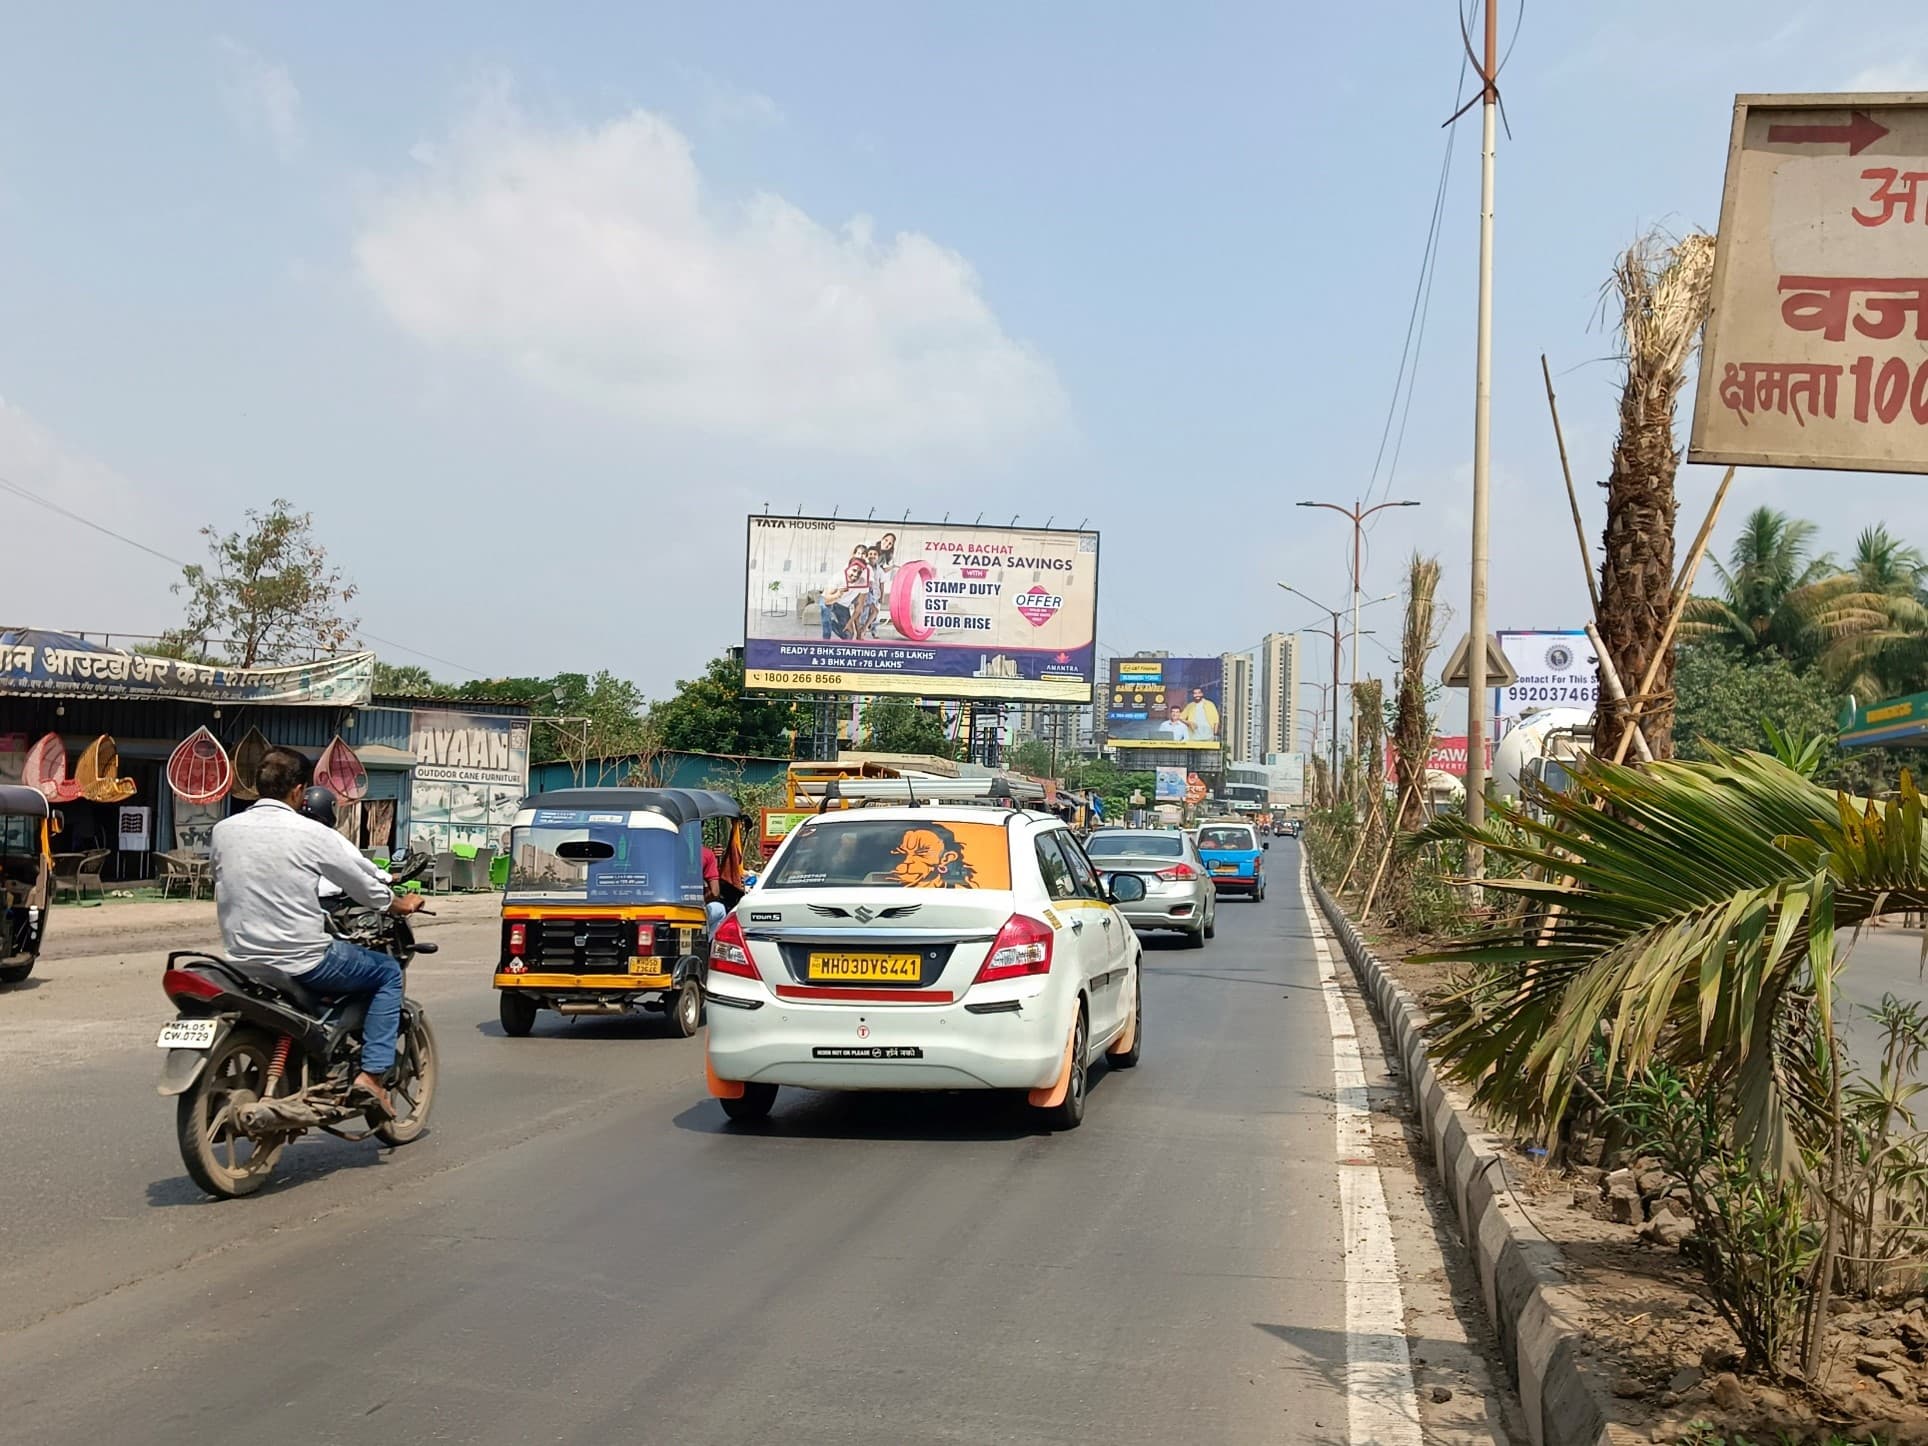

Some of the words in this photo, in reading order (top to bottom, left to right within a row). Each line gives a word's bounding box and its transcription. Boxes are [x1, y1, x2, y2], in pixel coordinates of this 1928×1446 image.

[1719, 362, 1843, 427] क्षमता
[754, 519, 786, 529] TATA
[789, 520, 836, 531] HOUSING
[925, 541, 964, 553] ZYADA
[968, 544, 1014, 555] BACHAT
[952, 554, 1001, 567] ZYADA
[1007, 558, 1073, 571] SAVINGS
[925, 581, 966, 594] STAMP
[969, 583, 1001, 596] DUTY
[925, 598, 948, 611] GST
[1016, 594, 1062, 607] OFFER
[924, 615, 961, 628] FLOOR
[963, 617, 991, 630] RISE
[780, 646, 808, 655] READY
[809, 647, 815, 655] 2
[836, 648, 876, 657] STARTING
[878, 650, 888, 658] AT
[846, 659, 857, 667] AT
[765, 673, 789, 683] 1800
[792, 674, 812, 683] 266
[815, 674, 842, 684] 8566
[1552, 675, 1566, 683] For
[1570, 675, 1587, 683] This
[417, 729, 509, 769] AYAAN
[418, 769, 457, 778] OUTDOOR
[459, 771, 479, 780] CANE
[481, 773, 520, 782] FURNITURE
